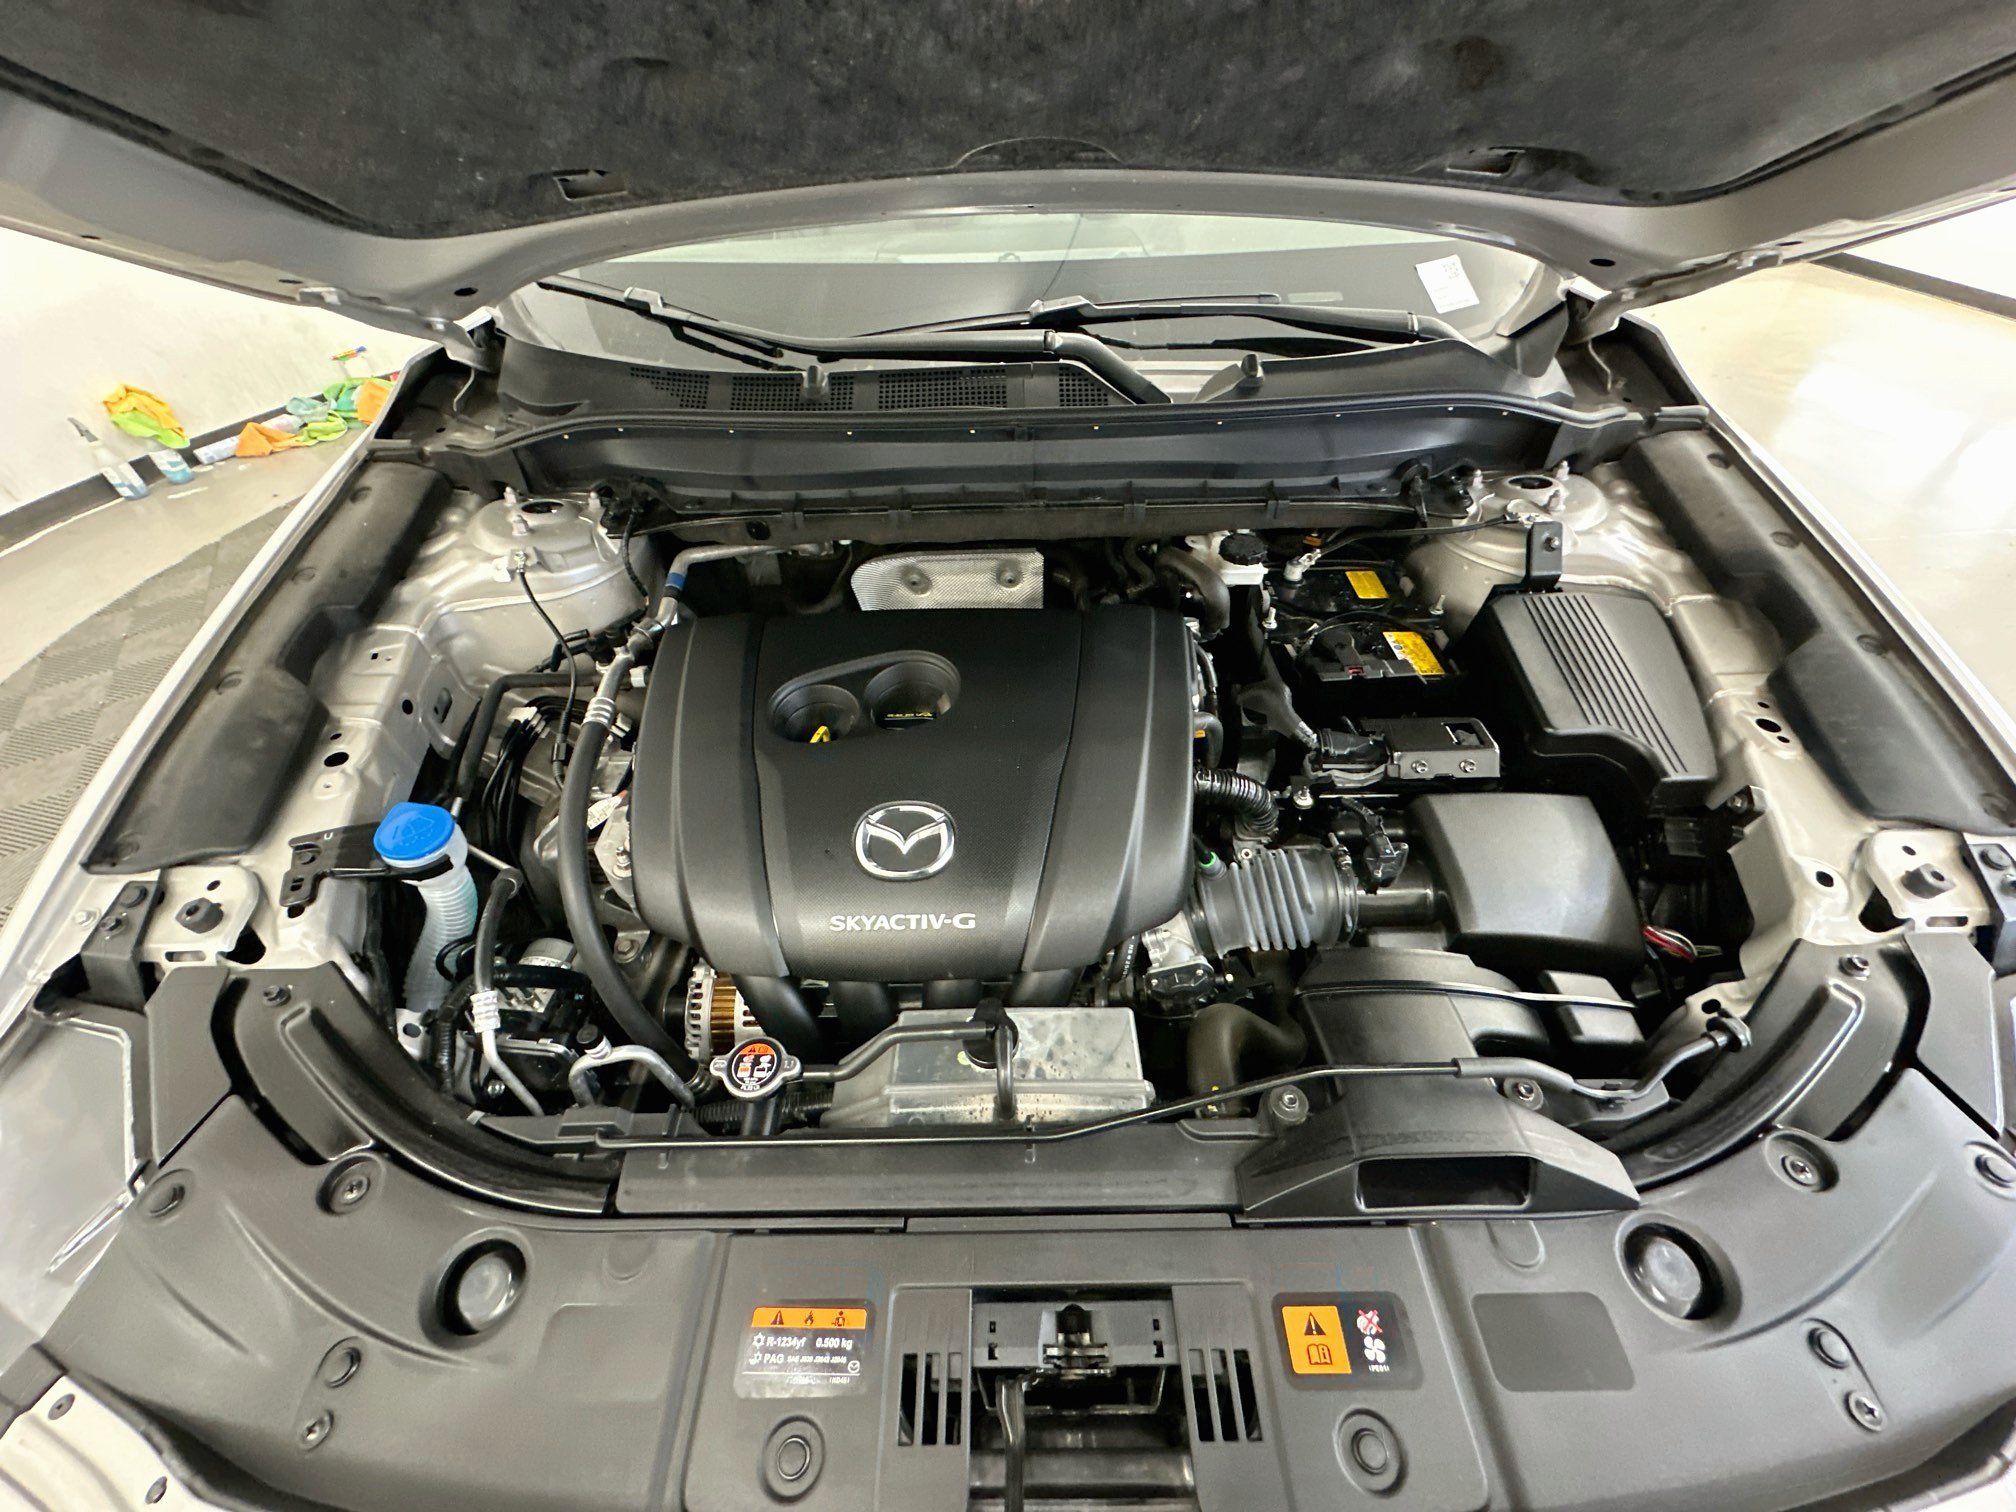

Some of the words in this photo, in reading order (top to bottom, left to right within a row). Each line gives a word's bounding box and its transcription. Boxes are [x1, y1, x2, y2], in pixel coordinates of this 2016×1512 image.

[829, 912, 976, 931] SKYACTIV-G
[766, 1336, 807, 1349] R-1234yf
[816, 1337, 840, 1348] 0.500
[841, 1338, 853, 1350] kg
[763, 1353, 784, 1364] PAG
